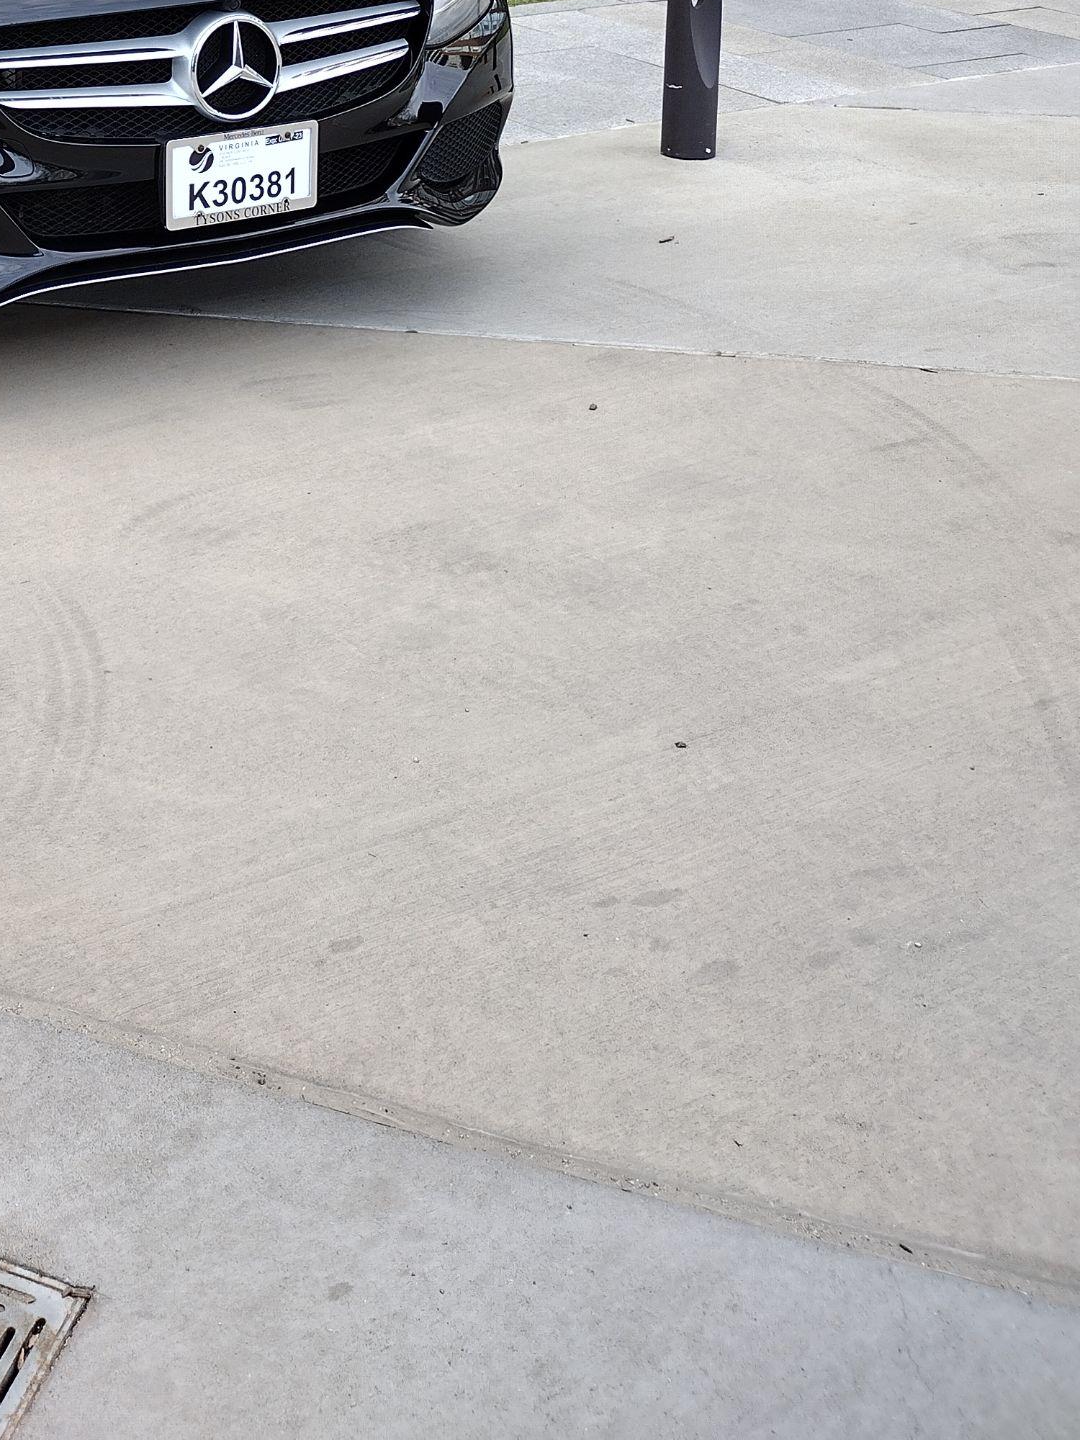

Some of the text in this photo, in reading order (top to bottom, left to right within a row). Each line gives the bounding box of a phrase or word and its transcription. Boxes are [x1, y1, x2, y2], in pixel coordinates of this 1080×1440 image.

[219, 140, 259, 151] VIRGINIA
[189, 167, 295, 211] K30381
[196, 201, 290, 225] TYSONS CORNER
